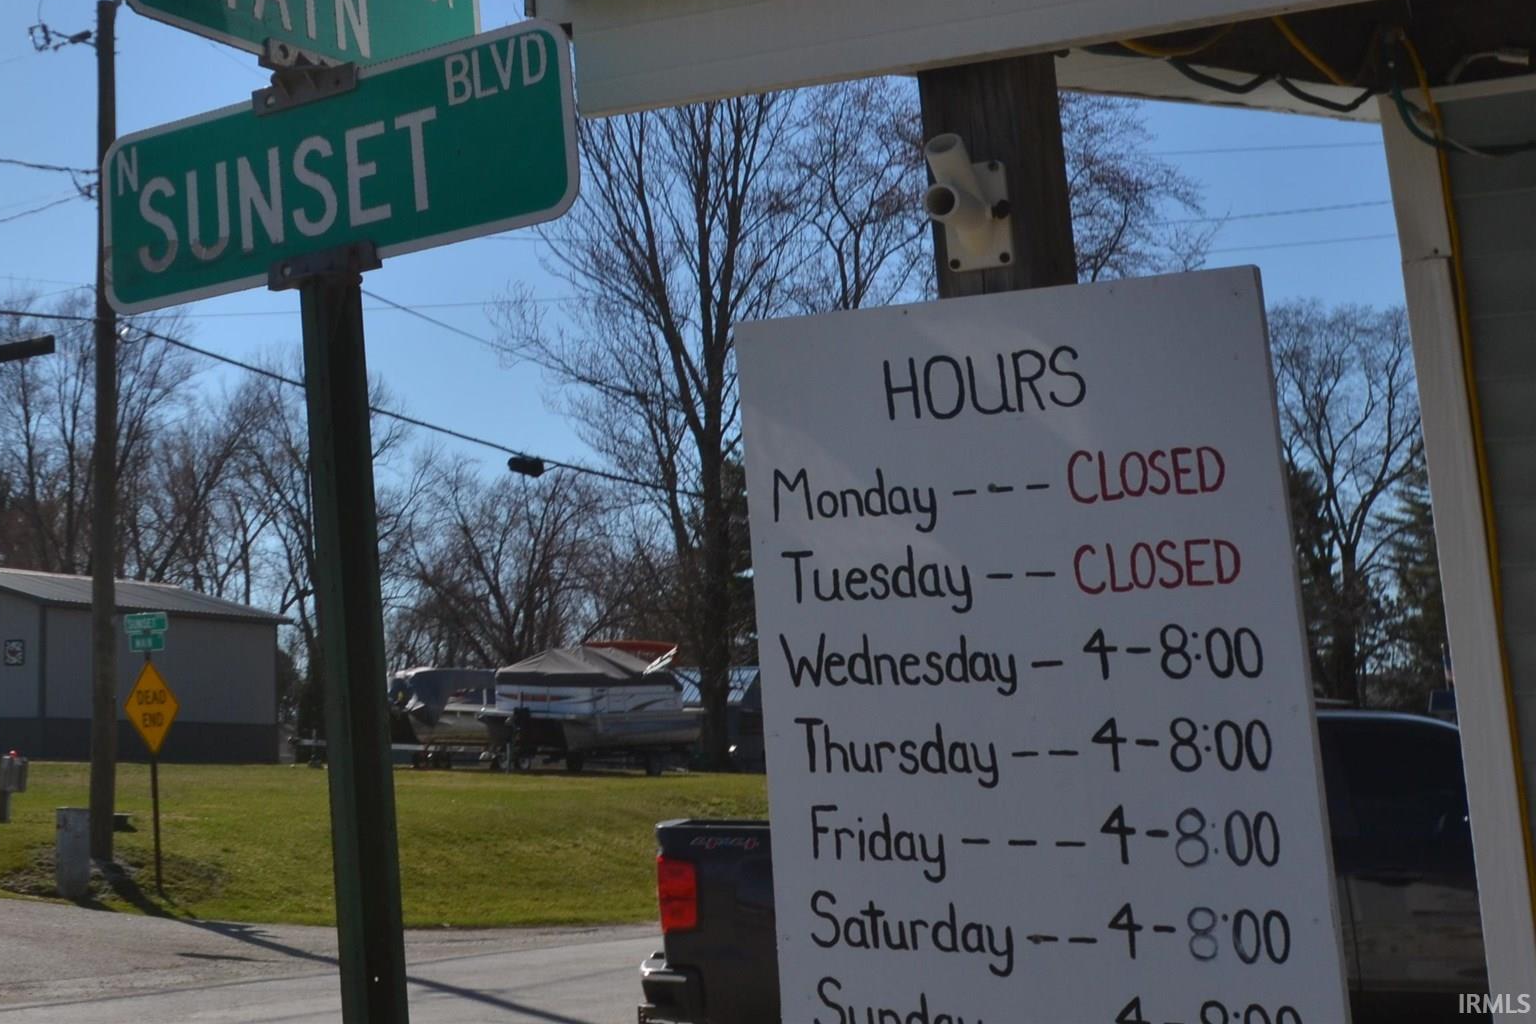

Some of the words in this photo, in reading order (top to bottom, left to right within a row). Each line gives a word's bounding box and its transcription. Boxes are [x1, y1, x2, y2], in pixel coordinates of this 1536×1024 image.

[116, 145, 139, 196] N
[137, 106, 437, 274] SUNSET
[443, 33, 548, 106] BLVD
[882, 345, 1087, 421] HOURS
[772, 467, 938, 533] Monday
[1067, 445, 1226, 504] CLOSED
[780, 544, 973, 613] Tuesday
[1073, 538, 1241, 595] CLOSED
[136, 689, 167, 705] DEAD
[779, 632, 1018, 697] Wednesday
[142, 712, 164, 728] END
[794, 717, 1000, 789] Thursday
[810, 804, 947, 884] Friday
[810, 889, 1014, 977] Saturday
